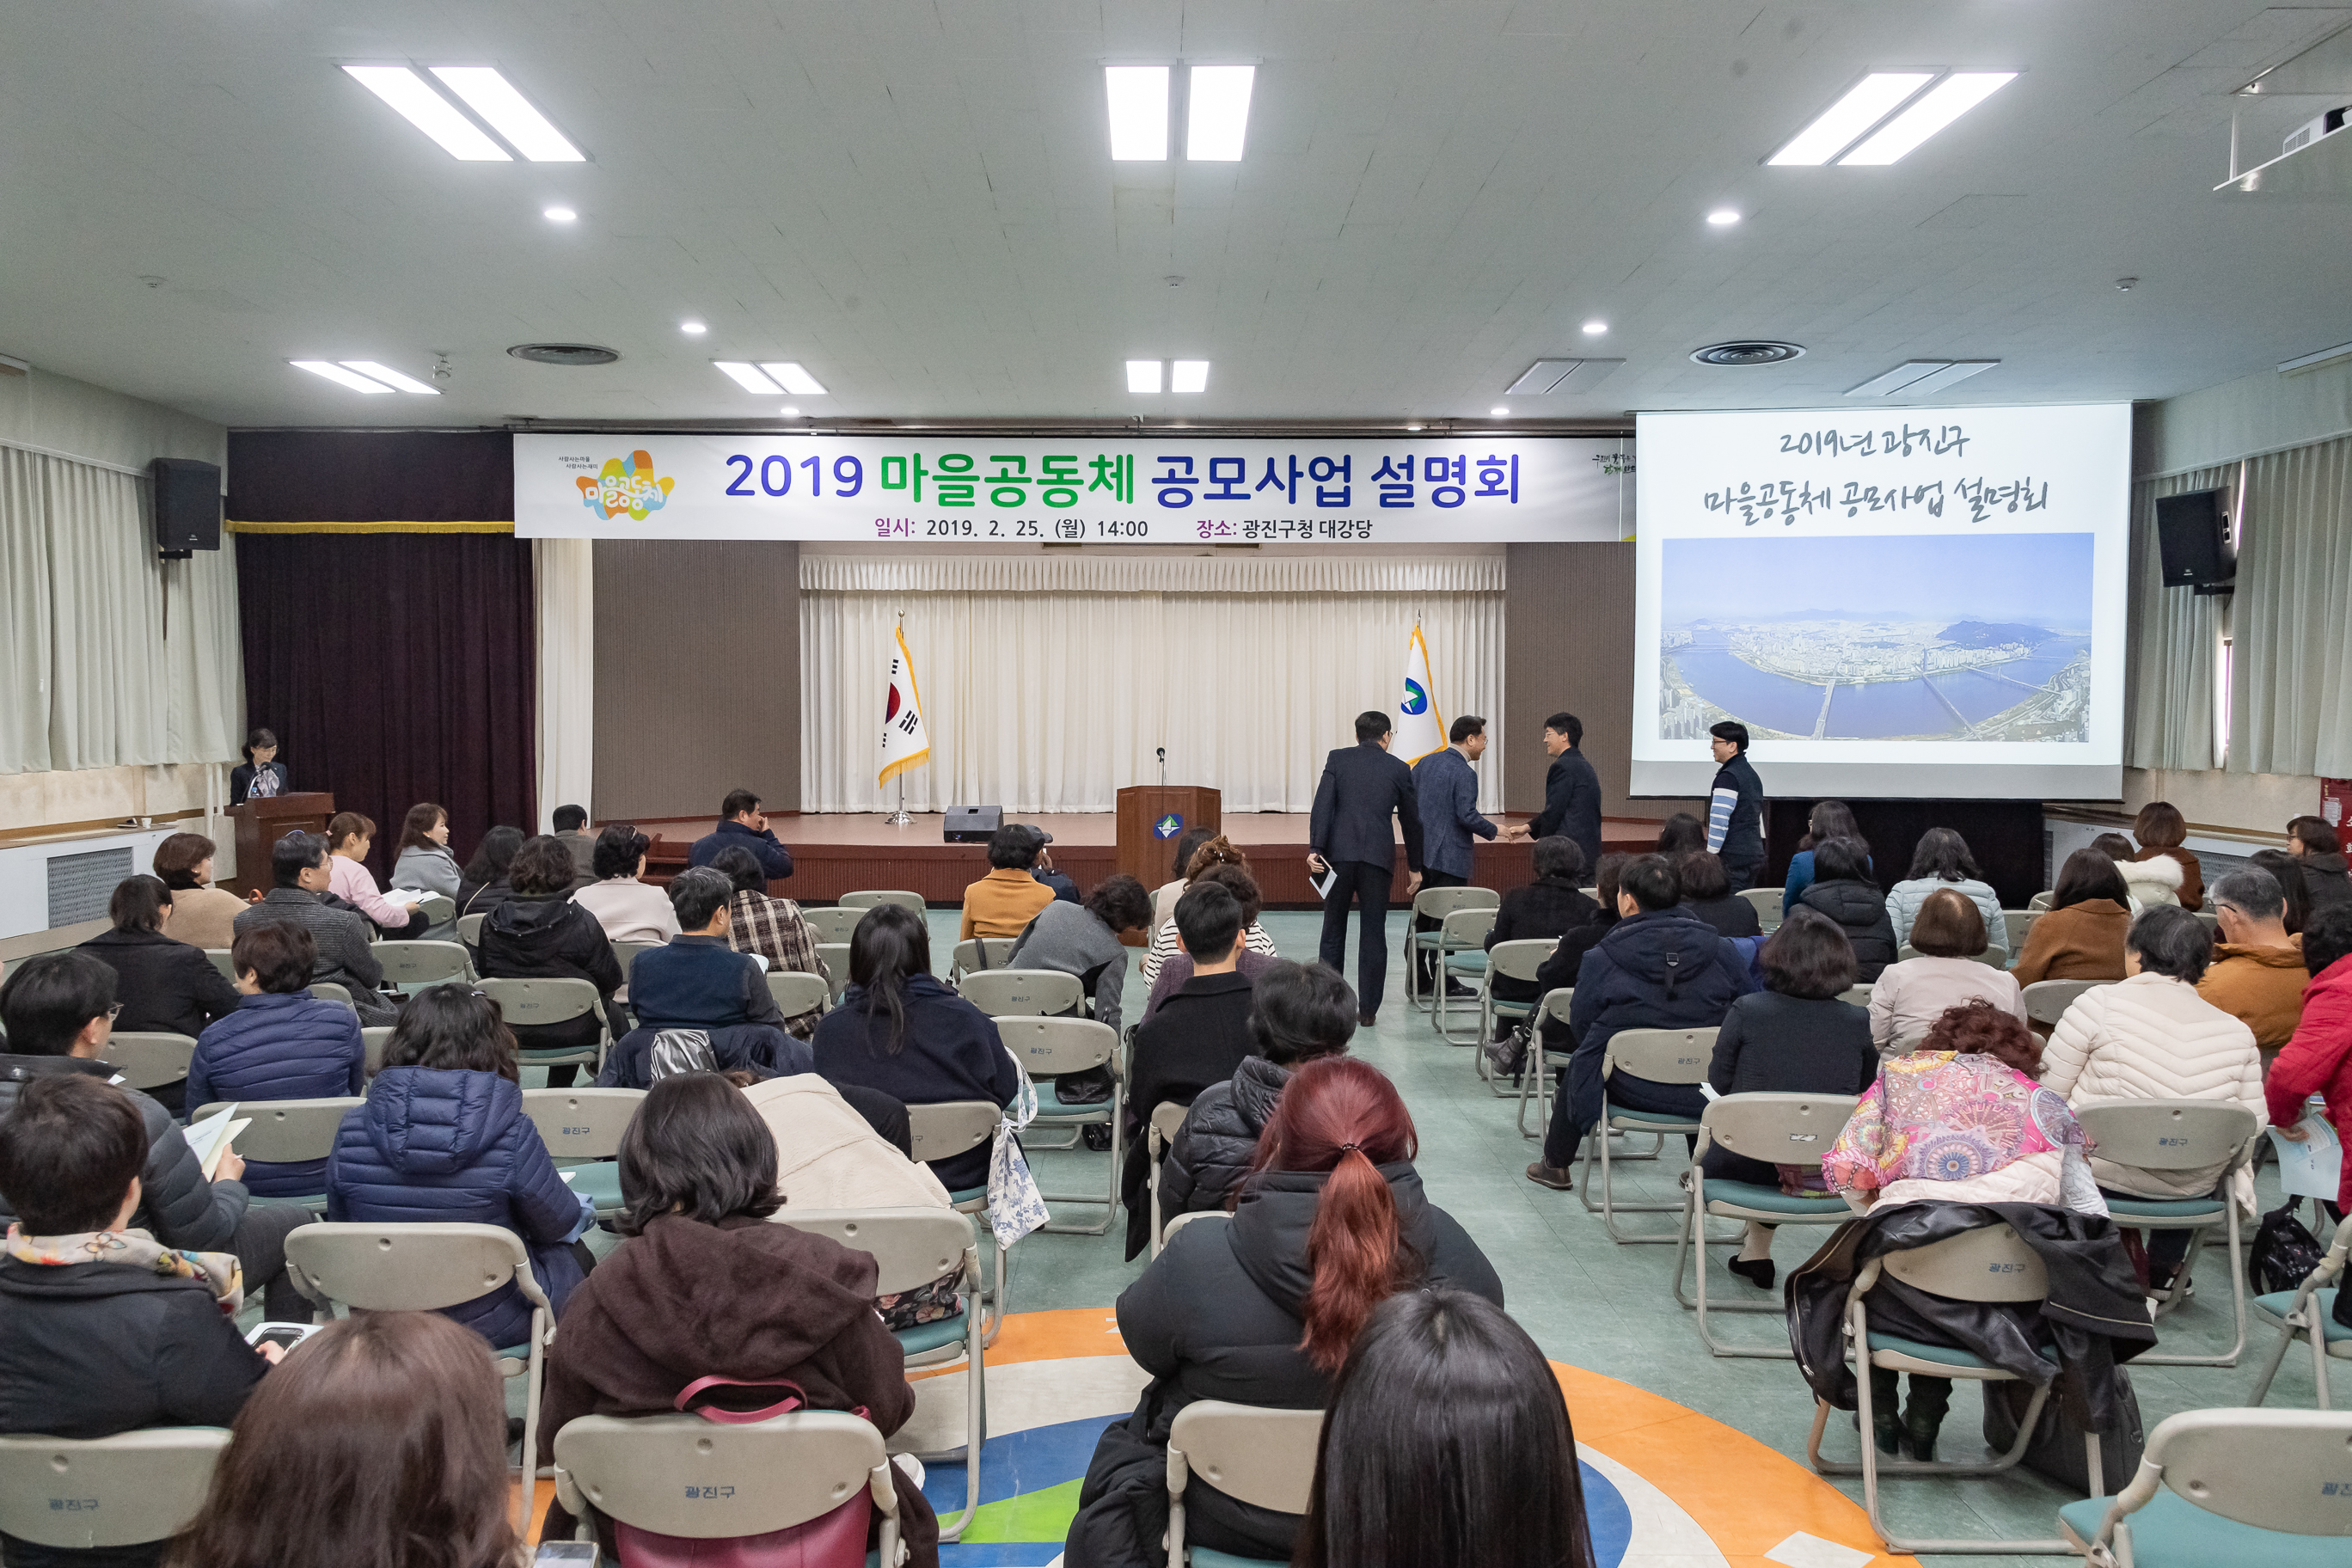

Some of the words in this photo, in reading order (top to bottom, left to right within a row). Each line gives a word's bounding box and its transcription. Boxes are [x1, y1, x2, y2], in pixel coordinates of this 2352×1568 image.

[1780, 429, 1877, 457] 2019년
[1882, 424, 1970, 457] 광진구
[725, 454, 863, 498] 2019
[880, 452, 1134, 509] 마을공동체
[1151, 454, 1352, 509] 공모사업
[1370, 453, 1520, 509] 설명회
[1705, 480, 1831, 526] 마을공동체
[1839, 480, 1945, 518] 공모사업
[1953, 476, 2049, 523] 설명회
[874, 518, 916, 537] 일시:
[927, 519, 978, 537] 2019.
[989, 520, 1005, 537] 2.
[1015, 520, 1044, 537] 25.
[1055, 518, 1086, 539] (월)
[1098, 520, 1148, 537] 14:00
[1196, 519, 1237, 539] 장소:
[1242, 519, 1313, 539] 광진구청
[1319, 519, 1374, 539] 대강당
[2159, 1137, 2188, 1146] 광진구
[1988, 1263, 2025, 1273] 광진구
[684, 1485, 736, 1499] 광진구
[48, 1498, 100, 1511] 광진구
